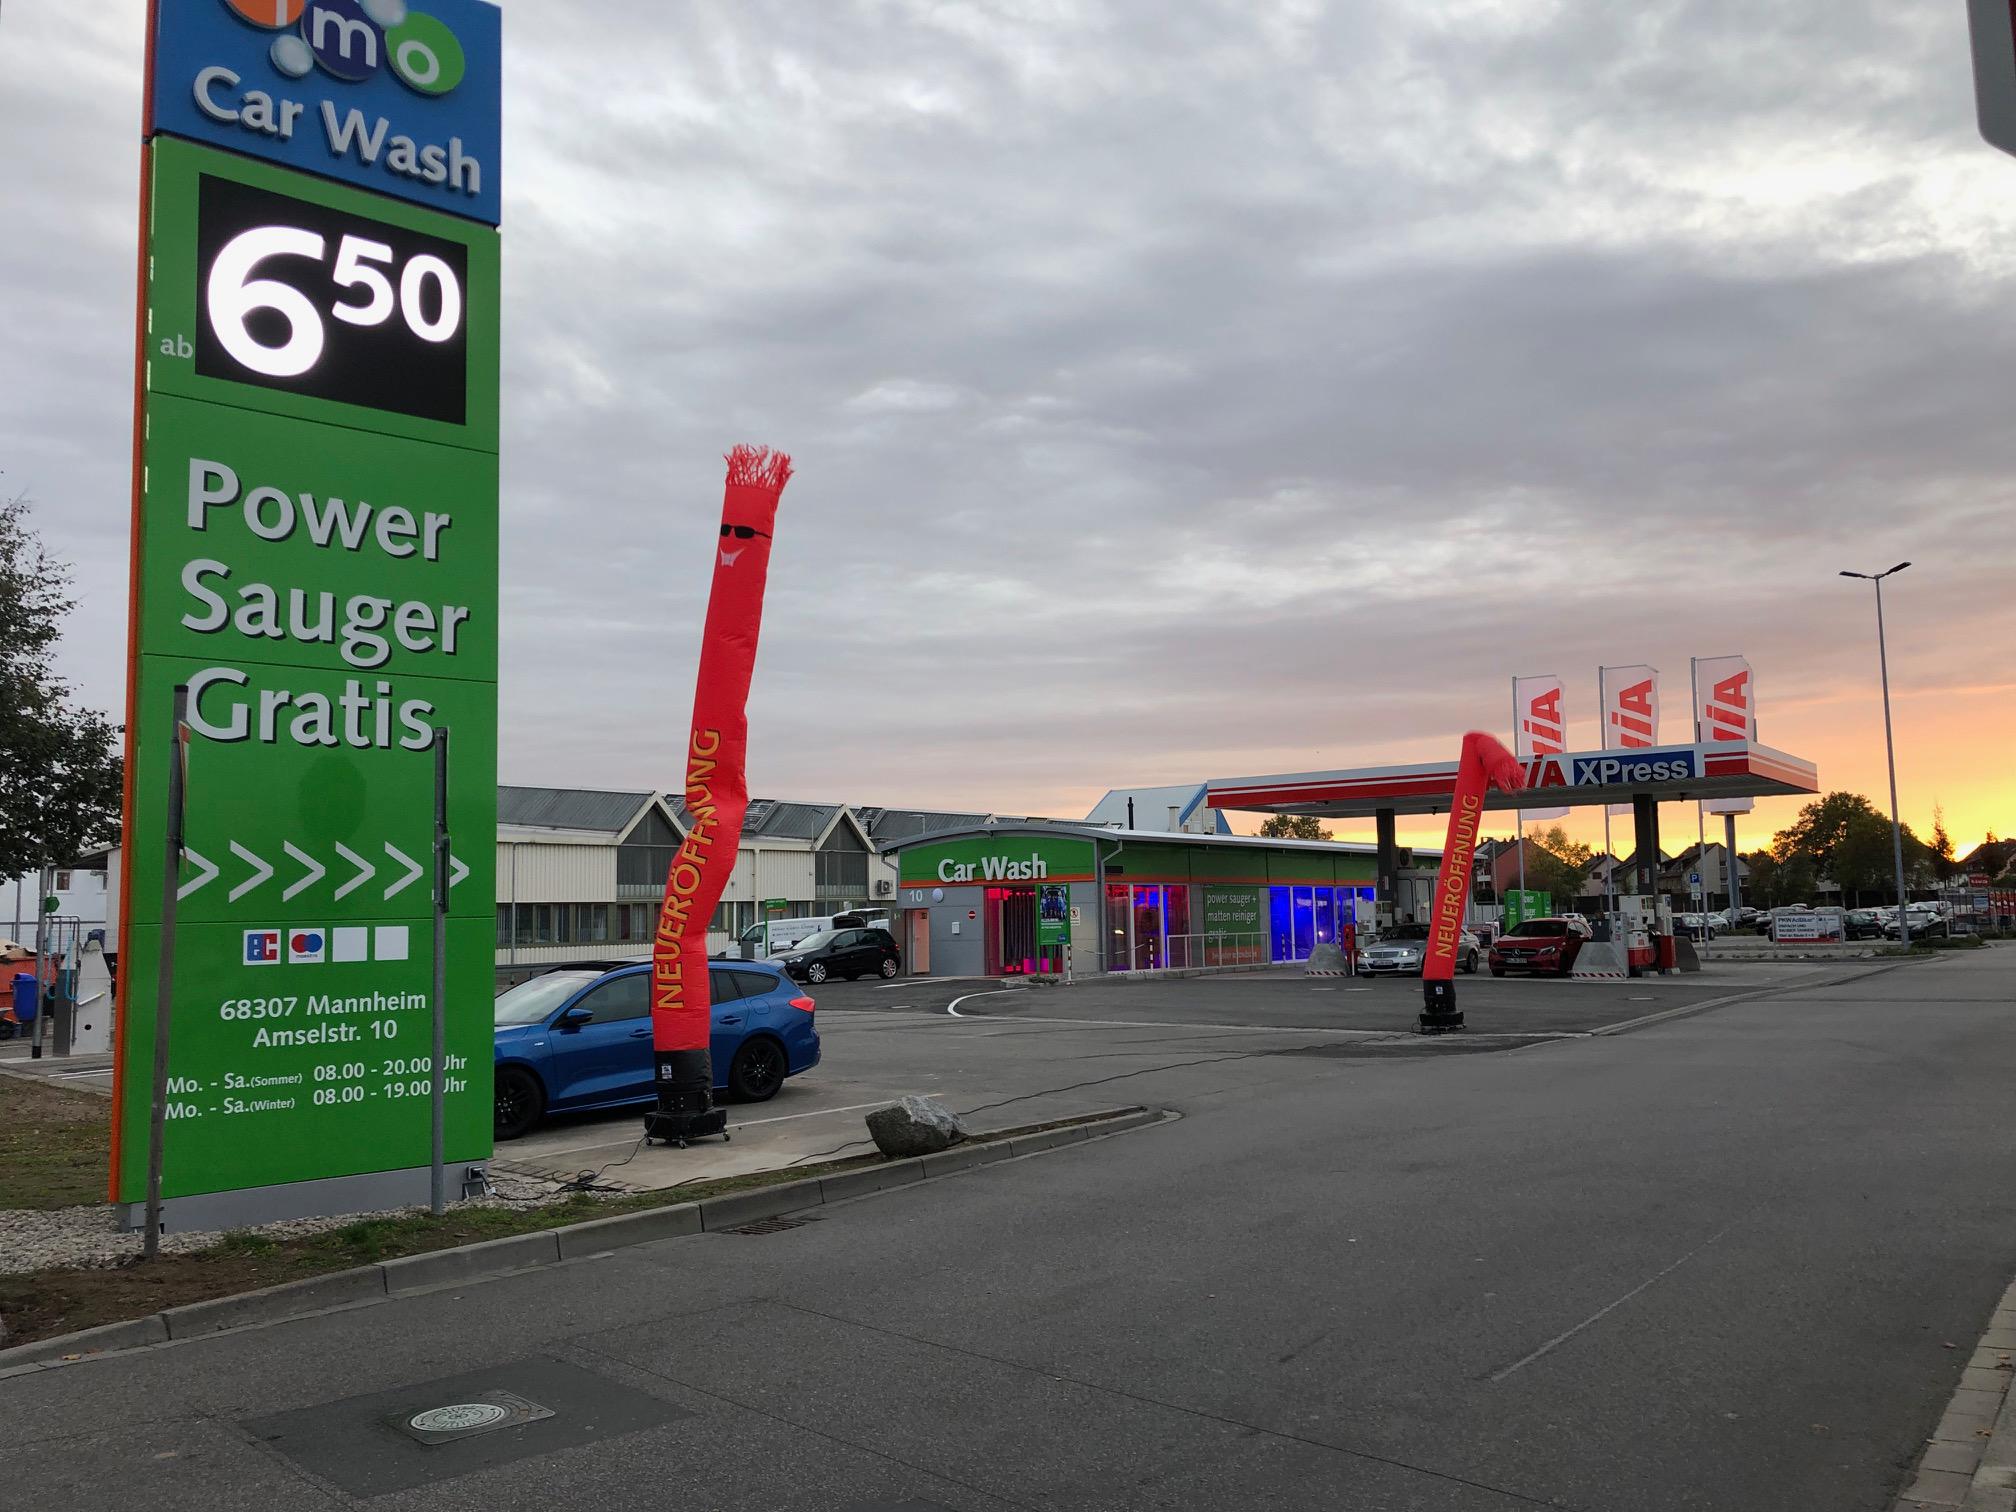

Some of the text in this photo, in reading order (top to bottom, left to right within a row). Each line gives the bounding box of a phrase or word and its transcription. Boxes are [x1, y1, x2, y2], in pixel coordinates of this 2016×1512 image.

[192, 66, 481, 195] Car Wash
[160, 333, 194, 360] ab
[187, 457, 451, 562] Power
[181, 558, 470, 668] Sauger
[186, 666, 436, 752] Gratis
[1576, 759, 1689, 785] XPress
[656, 729, 720, 1009] NEUERÖFFNUNG
[938, 853, 1048, 883] Car Wash
[1436, 793, 1479, 958] NEUERÖFFNUNG
[909, 890, 923, 902] 10
[1207, 894, 1228, 907] power
[1229, 894, 1251, 908] sauger
[1207, 909, 1257, 925] matten reiniger
[220, 991, 426, 1020] 68307 Mannheim
[253, 1020, 398, 1048] Amselstr. 10
[166, 1077, 203, 1094] Mo.
[314, 1062, 365, 1081] 08.00
[383, 1057, 432, 1076] 20.00
[164, 1103, 202, 1119] Mo.
[313, 1086, 364, 1105] 08.00
[384, 1080, 432, 1099] 19.00
